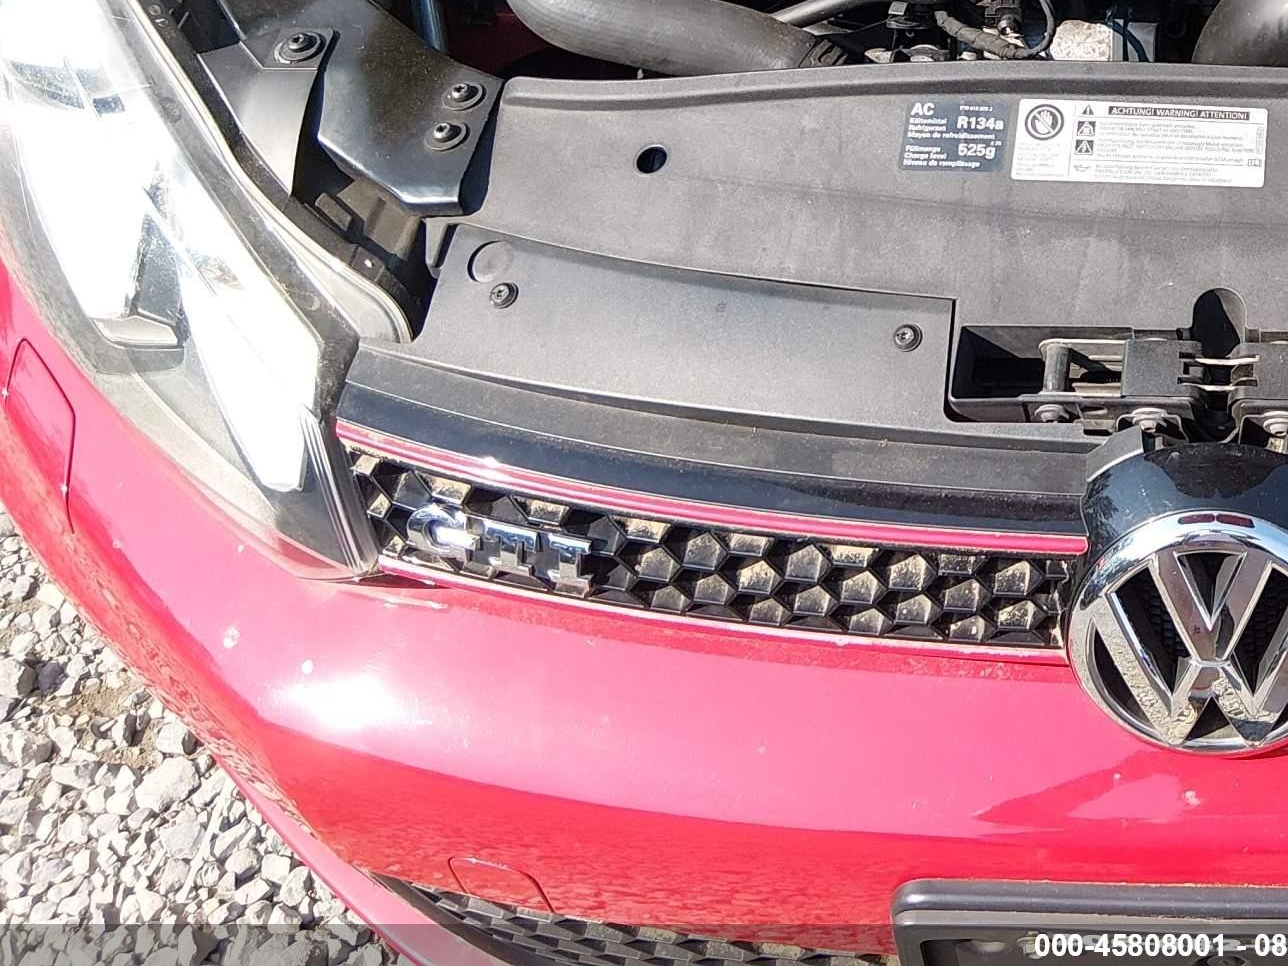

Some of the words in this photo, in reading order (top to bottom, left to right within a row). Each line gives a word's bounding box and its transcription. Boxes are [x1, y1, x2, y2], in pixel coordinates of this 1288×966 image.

[910, 102, 935, 116] AC
[1111, 106, 1155, 116] ACHTUNG!
[1156, 108, 1199, 118] WARNING!
[1200, 110, 1248, 120] ATTENTION!
[957, 115, 1004, 130] R134a
[958, 143, 996, 160] 525g
